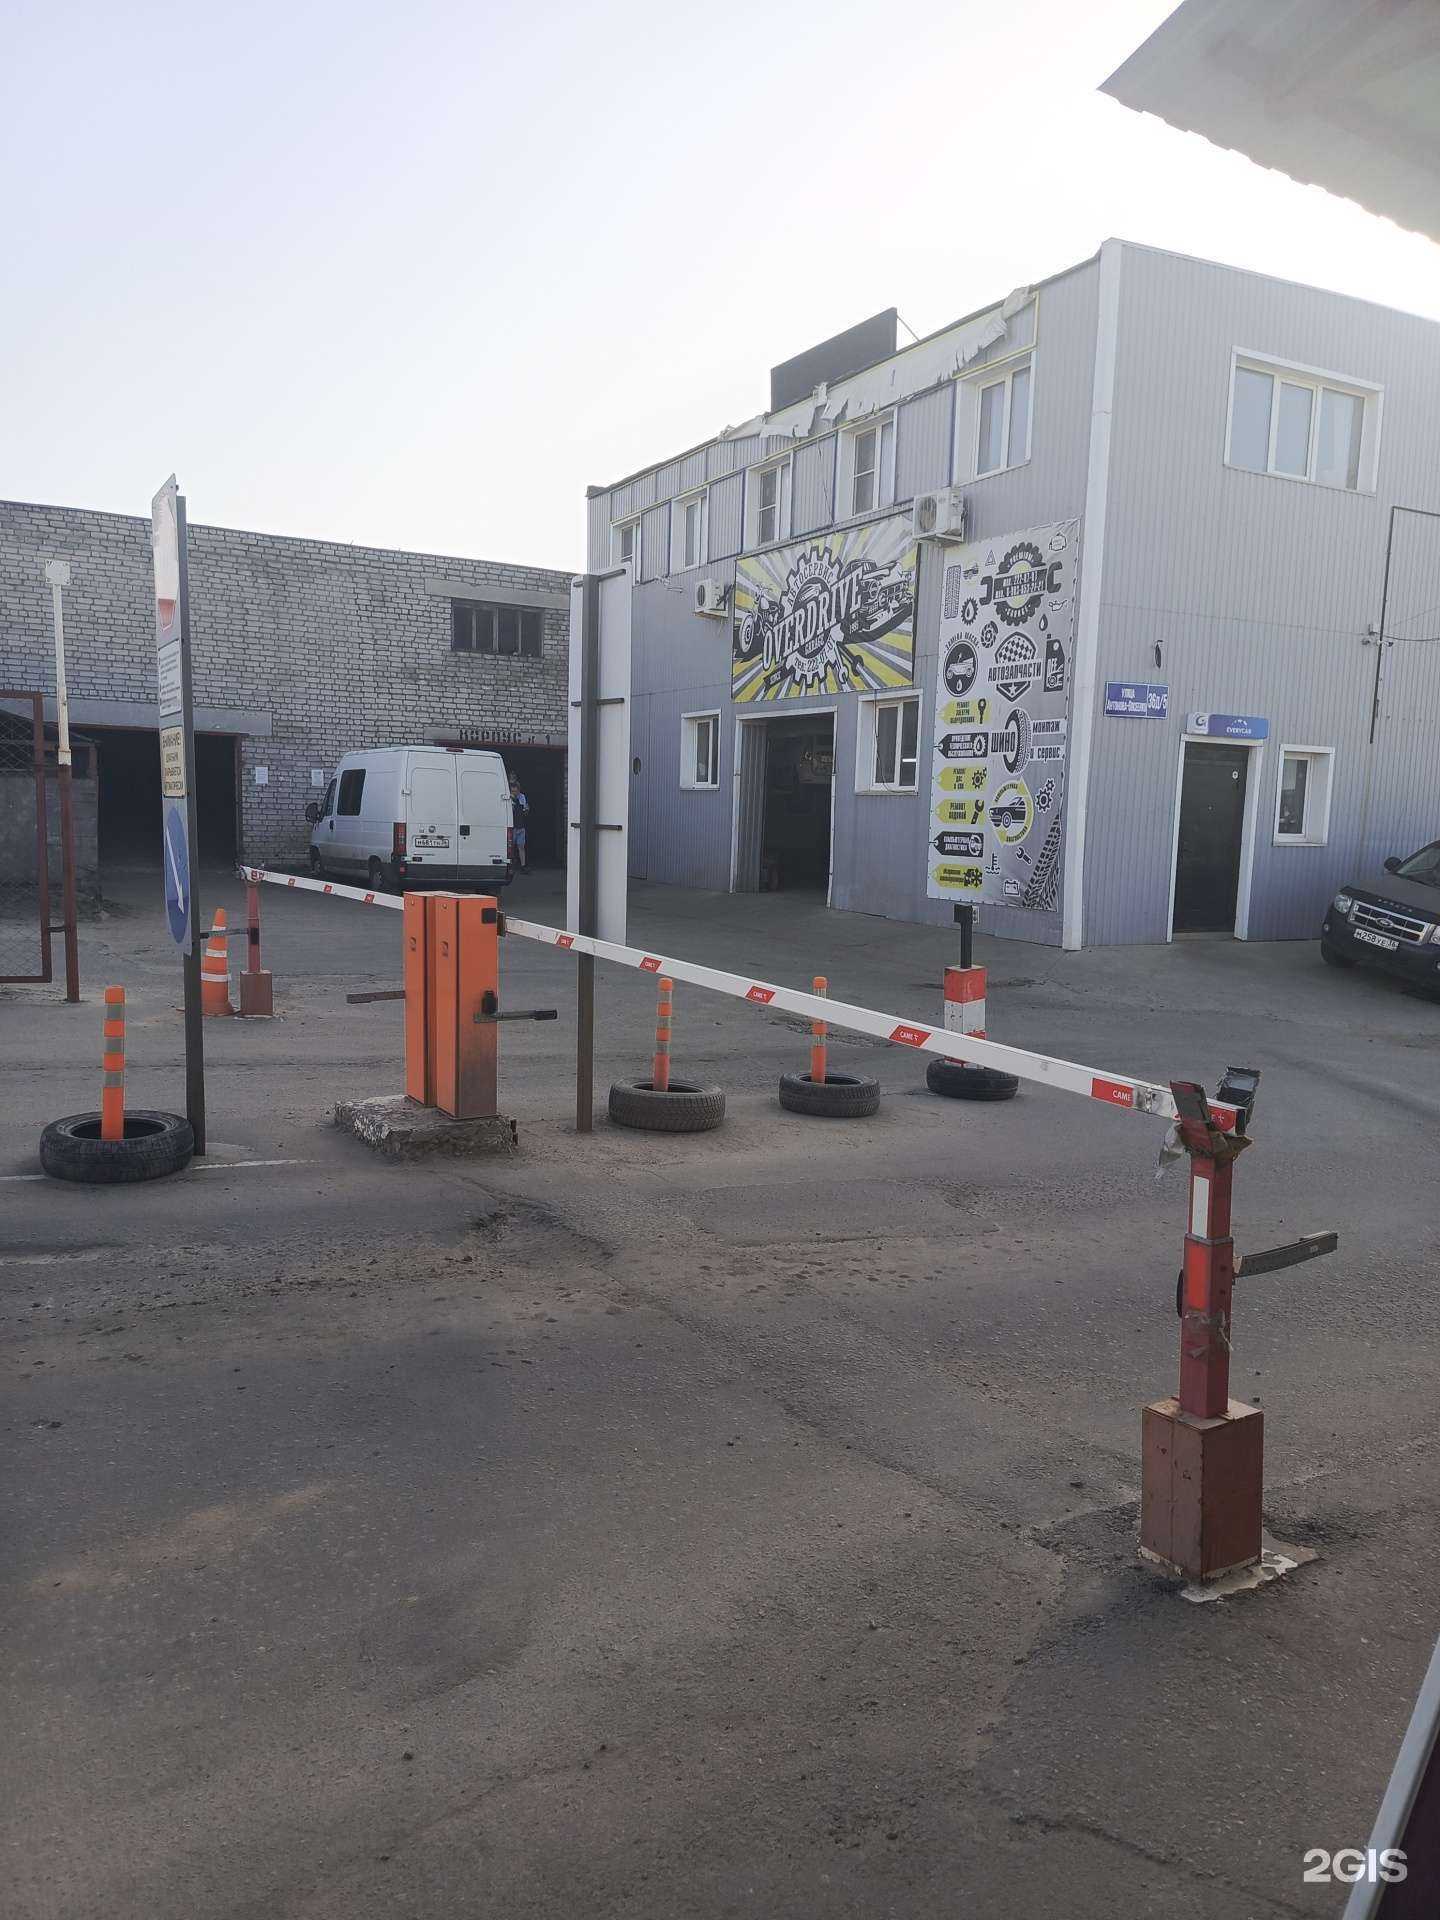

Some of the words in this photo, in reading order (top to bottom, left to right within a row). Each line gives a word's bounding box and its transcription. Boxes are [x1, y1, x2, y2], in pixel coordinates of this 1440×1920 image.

[788, 562, 834, 607] АВТОСЕРВИС
[762, 565, 864, 671] OVERDRIVE
[987, 661, 1042, 682] АВТОЗАПЧАСТИ
[991, 732, 1017, 753] ШИНО
[1112, 1089, 1132, 1102] CAME
